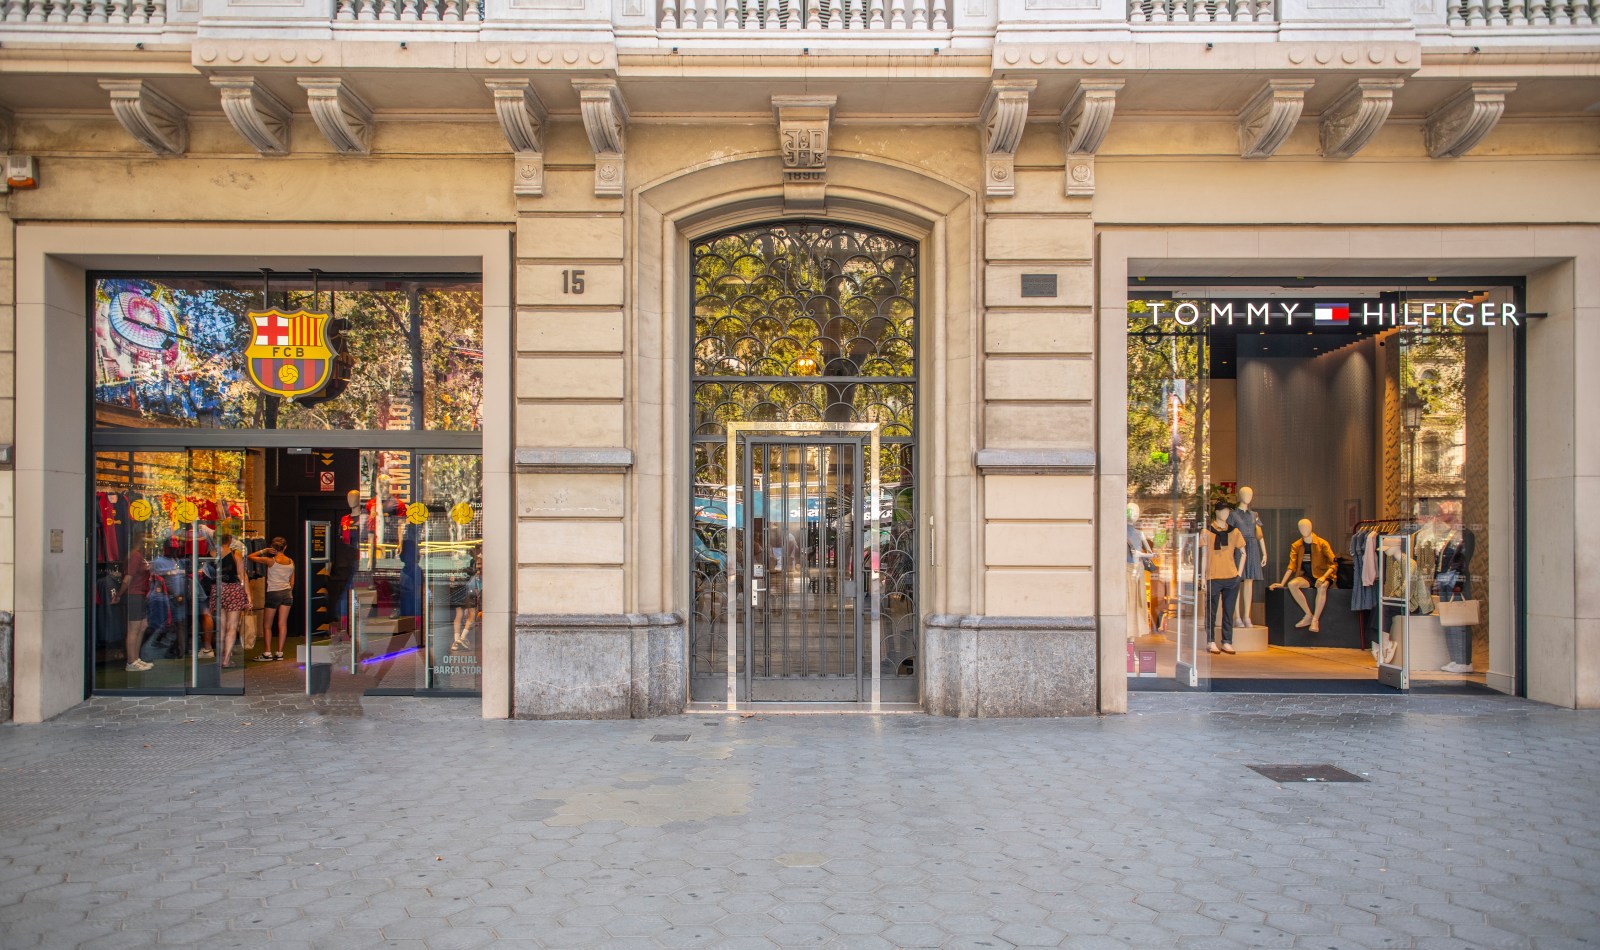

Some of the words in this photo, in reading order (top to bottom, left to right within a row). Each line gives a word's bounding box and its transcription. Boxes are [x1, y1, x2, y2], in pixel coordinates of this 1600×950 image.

[562, 270, 585, 294] 15
[1146, 303, 1299, 325] TOMMY
[1363, 303, 1519, 326] HILFIGER
[434, 666, 460, 675] BARÇA
[462, 666, 481, 674] STOR
